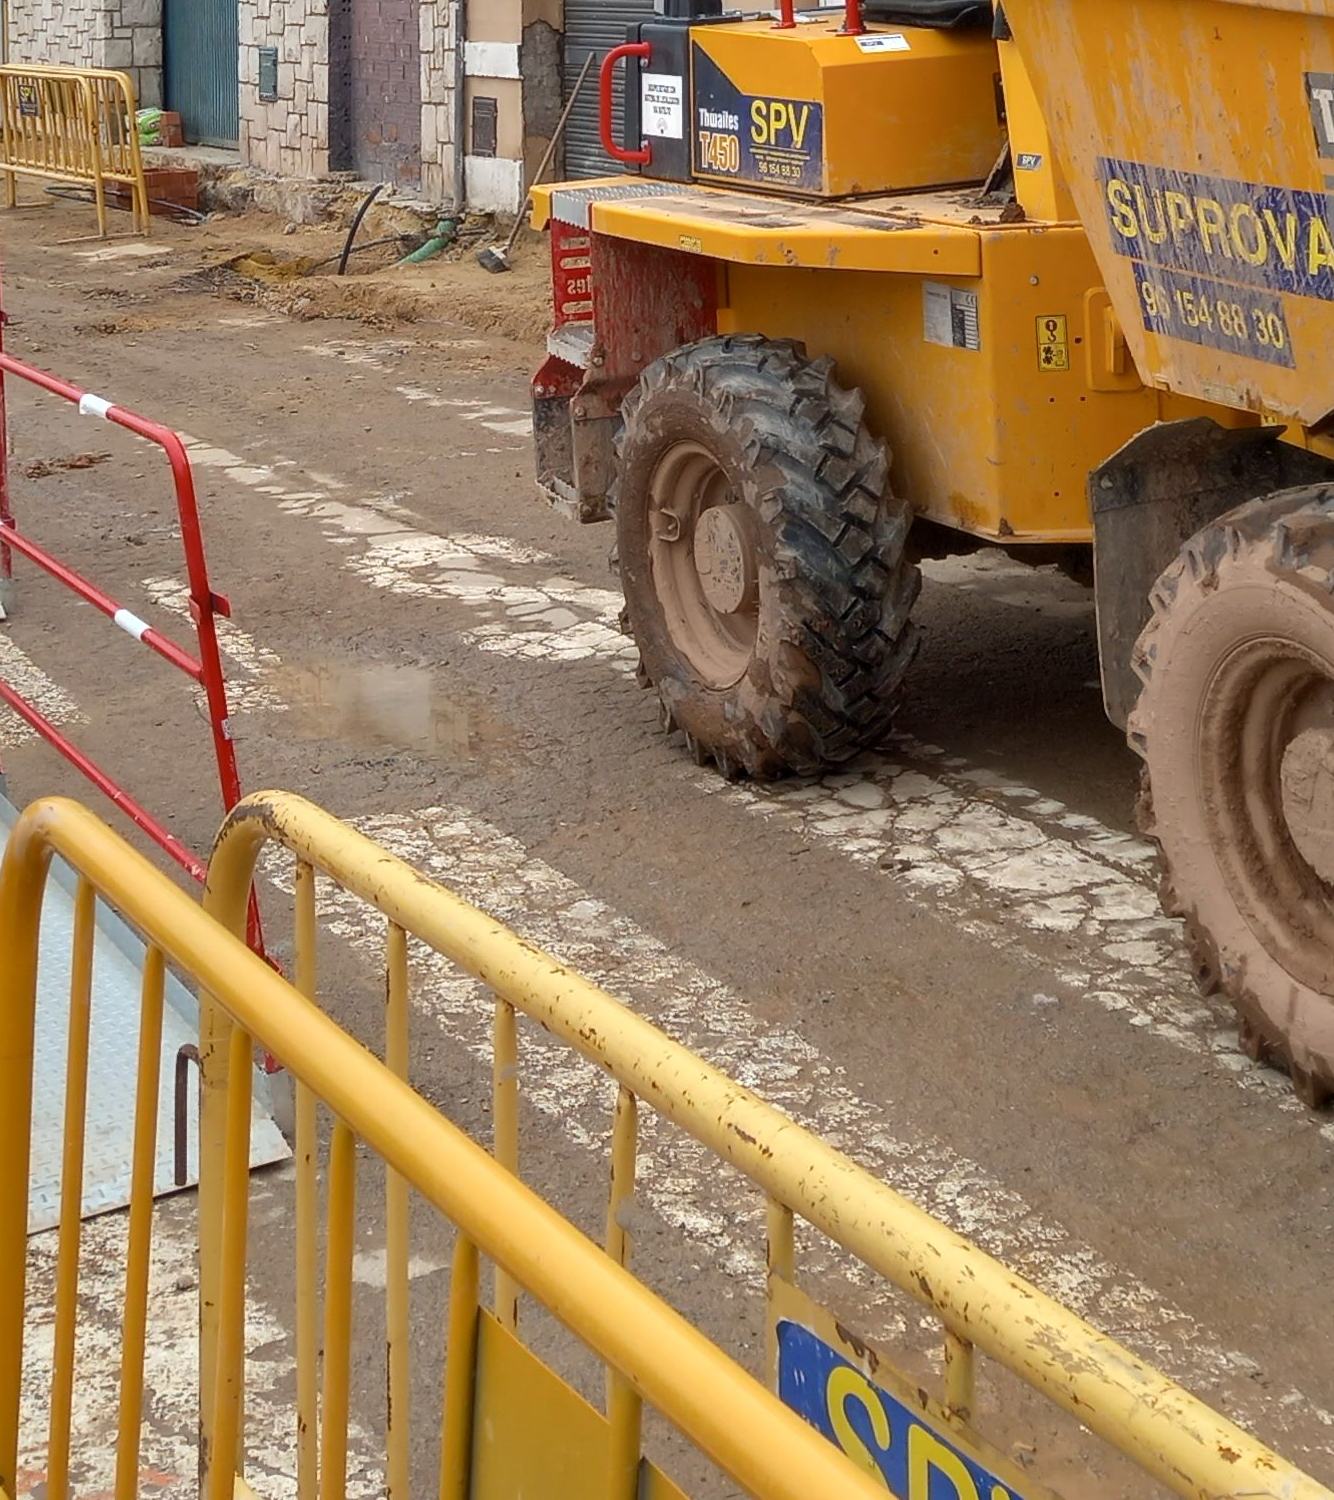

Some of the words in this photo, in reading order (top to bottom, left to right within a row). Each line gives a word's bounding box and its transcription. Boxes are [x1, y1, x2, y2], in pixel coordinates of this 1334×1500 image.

[751, 99, 809, 149] SPV
[699, 131, 740, 173] T450
[1142, 281, 1171, 321] 96
[1175, 289, 1213, 332] 154
[1216, 299, 1247, 341] 88
[1251, 308, 1284, 350] 30
